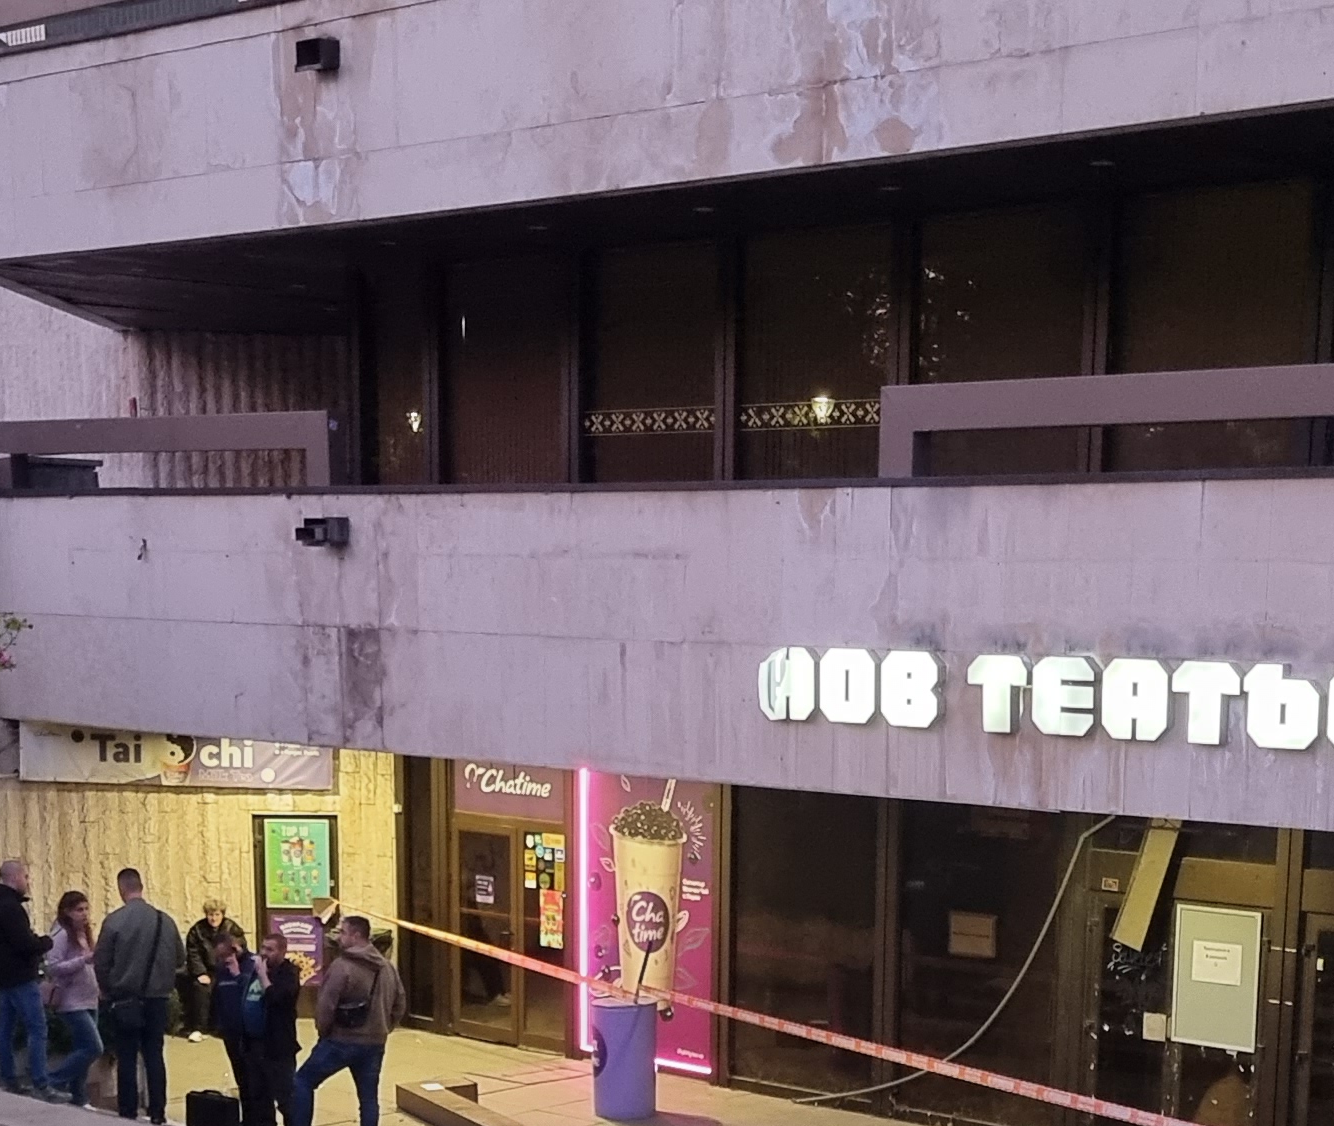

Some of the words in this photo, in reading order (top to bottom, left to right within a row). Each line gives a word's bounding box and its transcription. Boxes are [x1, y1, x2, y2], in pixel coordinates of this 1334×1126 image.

[758, 646, 943, 729] НОВ
[90, 733, 142, 764] Tai
[199, 737, 254, 769] chi
[481, 769, 551, 797] Chatime
[632, 901, 664, 922] Cha
[632, 922, 664, 942] time
